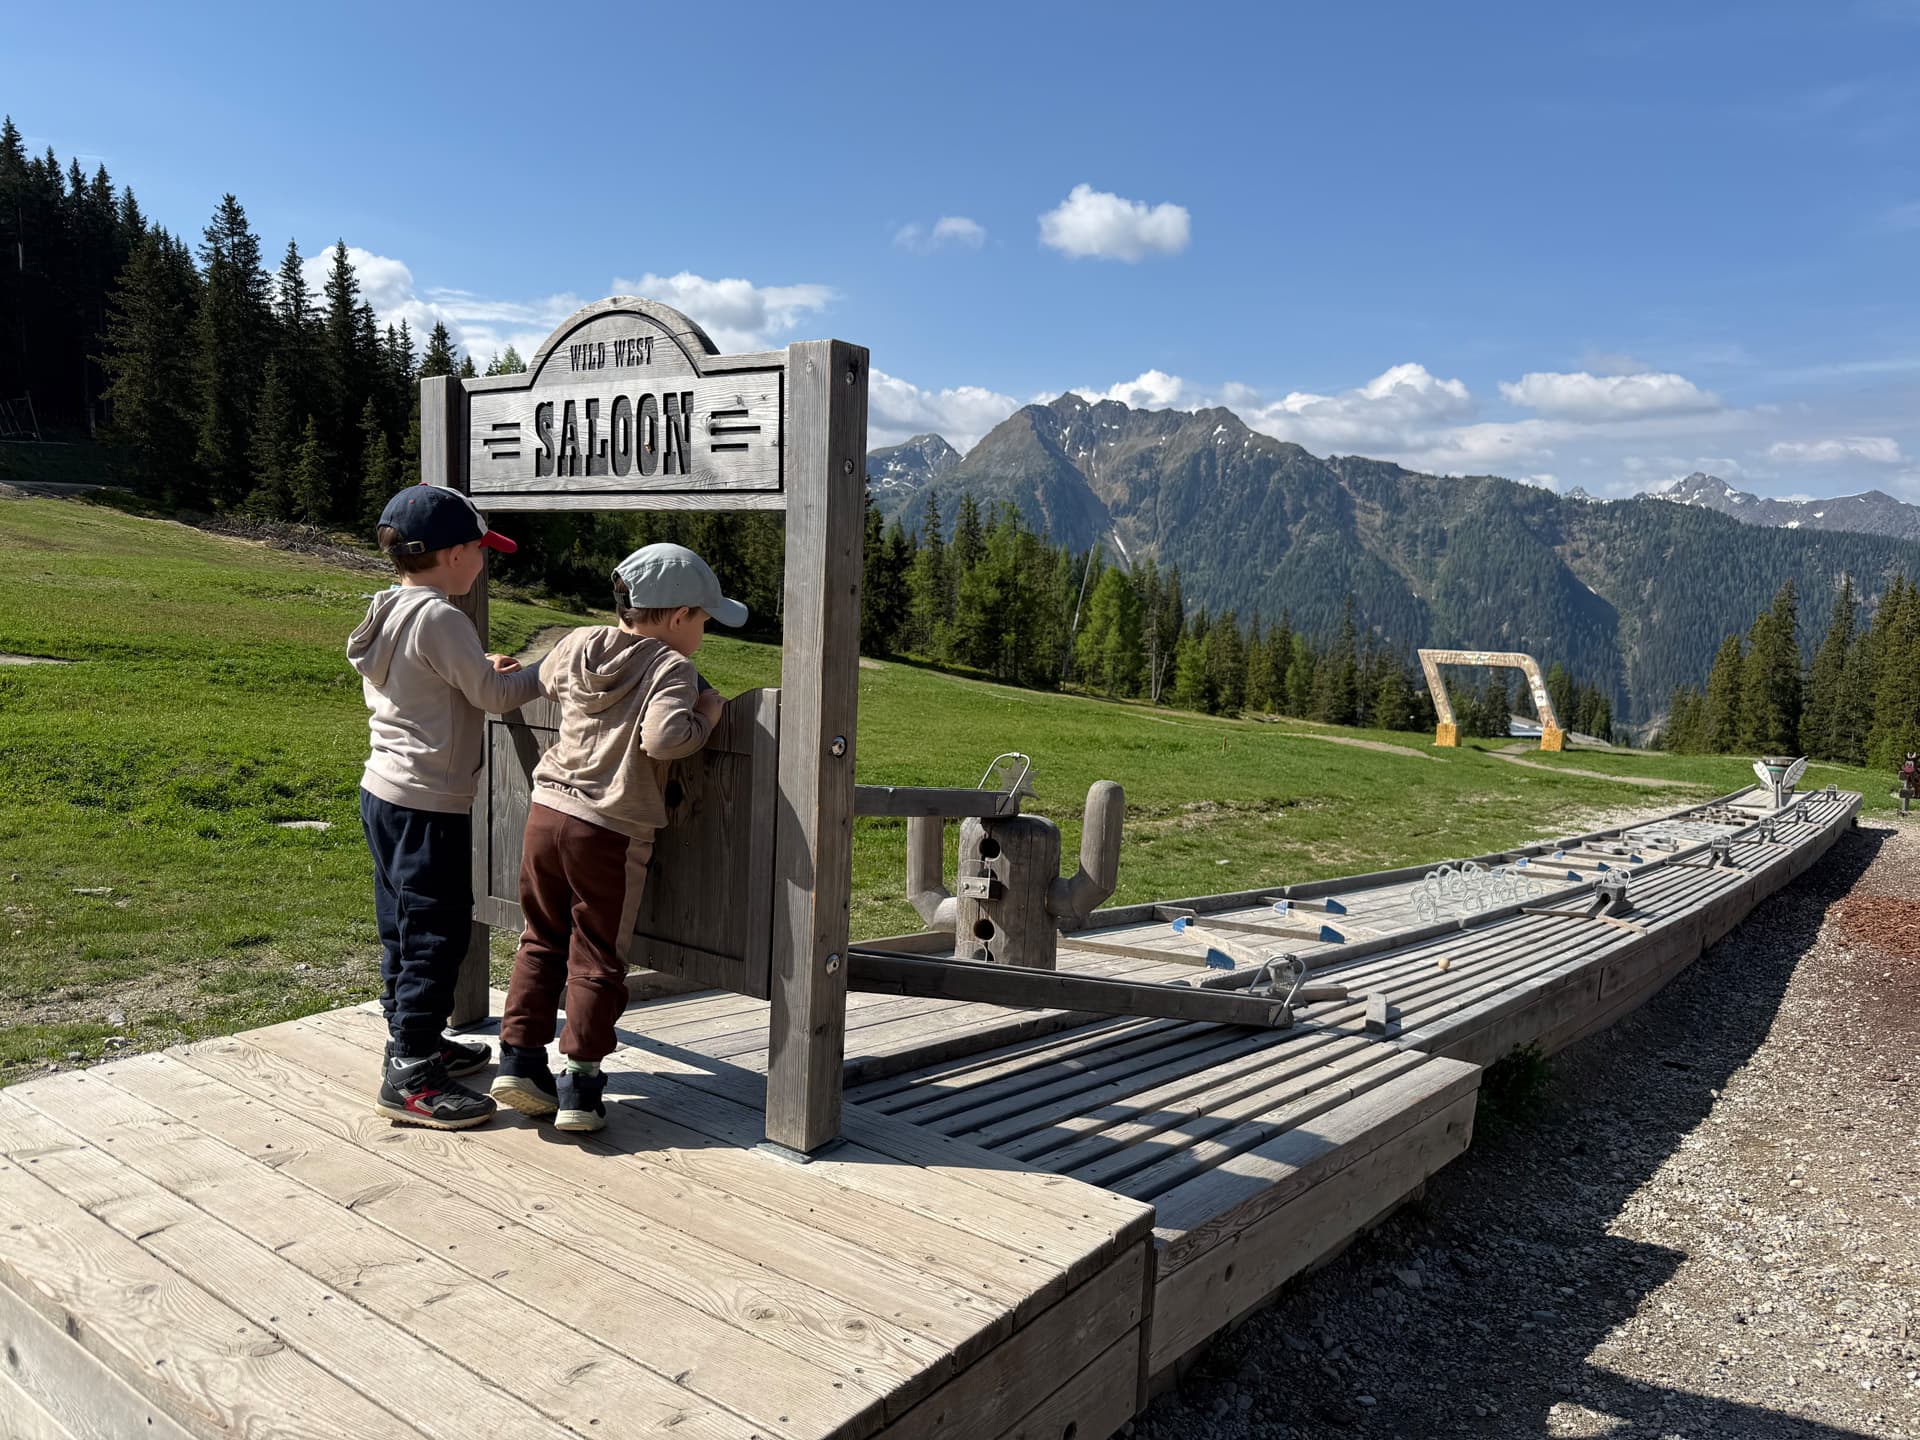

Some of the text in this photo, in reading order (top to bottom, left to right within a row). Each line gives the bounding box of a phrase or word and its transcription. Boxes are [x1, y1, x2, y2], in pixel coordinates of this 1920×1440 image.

[570, 337, 654, 371] WILD WEST
[535, 391, 694, 477] SALOON
